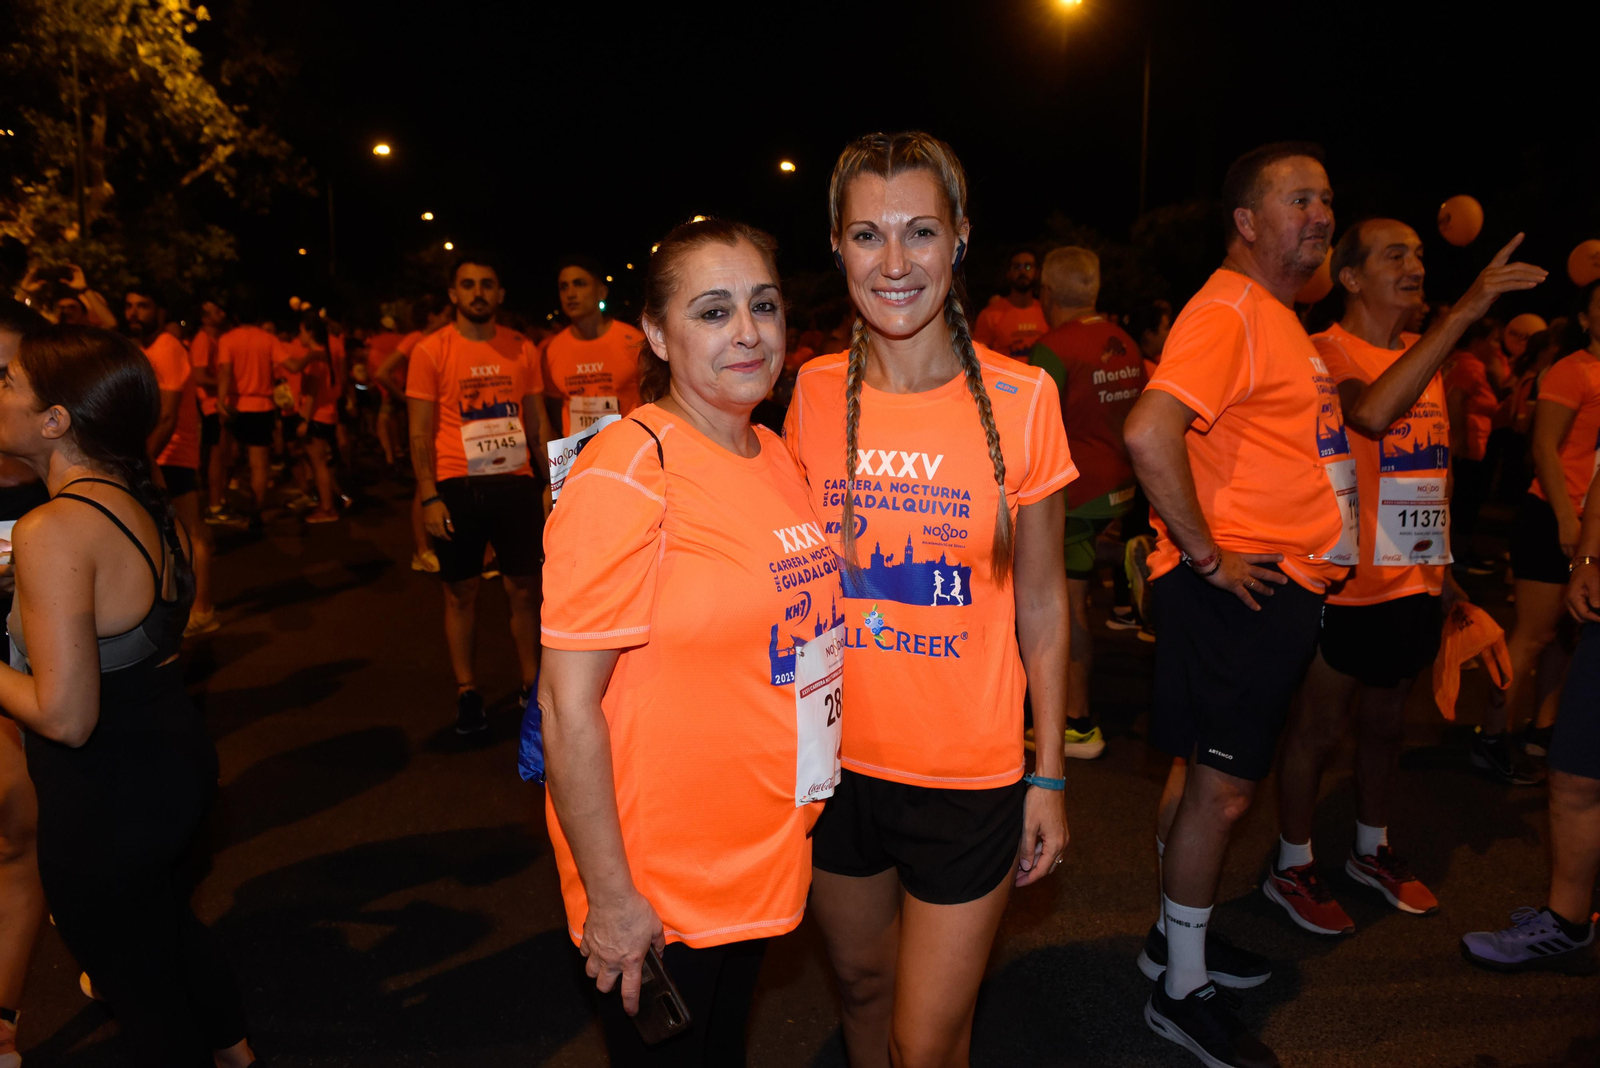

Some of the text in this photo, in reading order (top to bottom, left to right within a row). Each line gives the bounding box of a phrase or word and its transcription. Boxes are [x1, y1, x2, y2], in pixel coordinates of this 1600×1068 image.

[470, 364, 501, 378] XXXV
[576, 362, 604, 375] XXXV
[476, 436, 517, 453] 17145
[855, 449, 944, 481] XXXV
[889, 482, 972, 501] NOCTURNA
[1398, 509, 1447, 528] 11373
[772, 520, 827, 555] XXXV
[769, 555, 810, 574] CARRERA
[774, 574, 783, 593] DEL
[824, 683, 844, 728] 28
